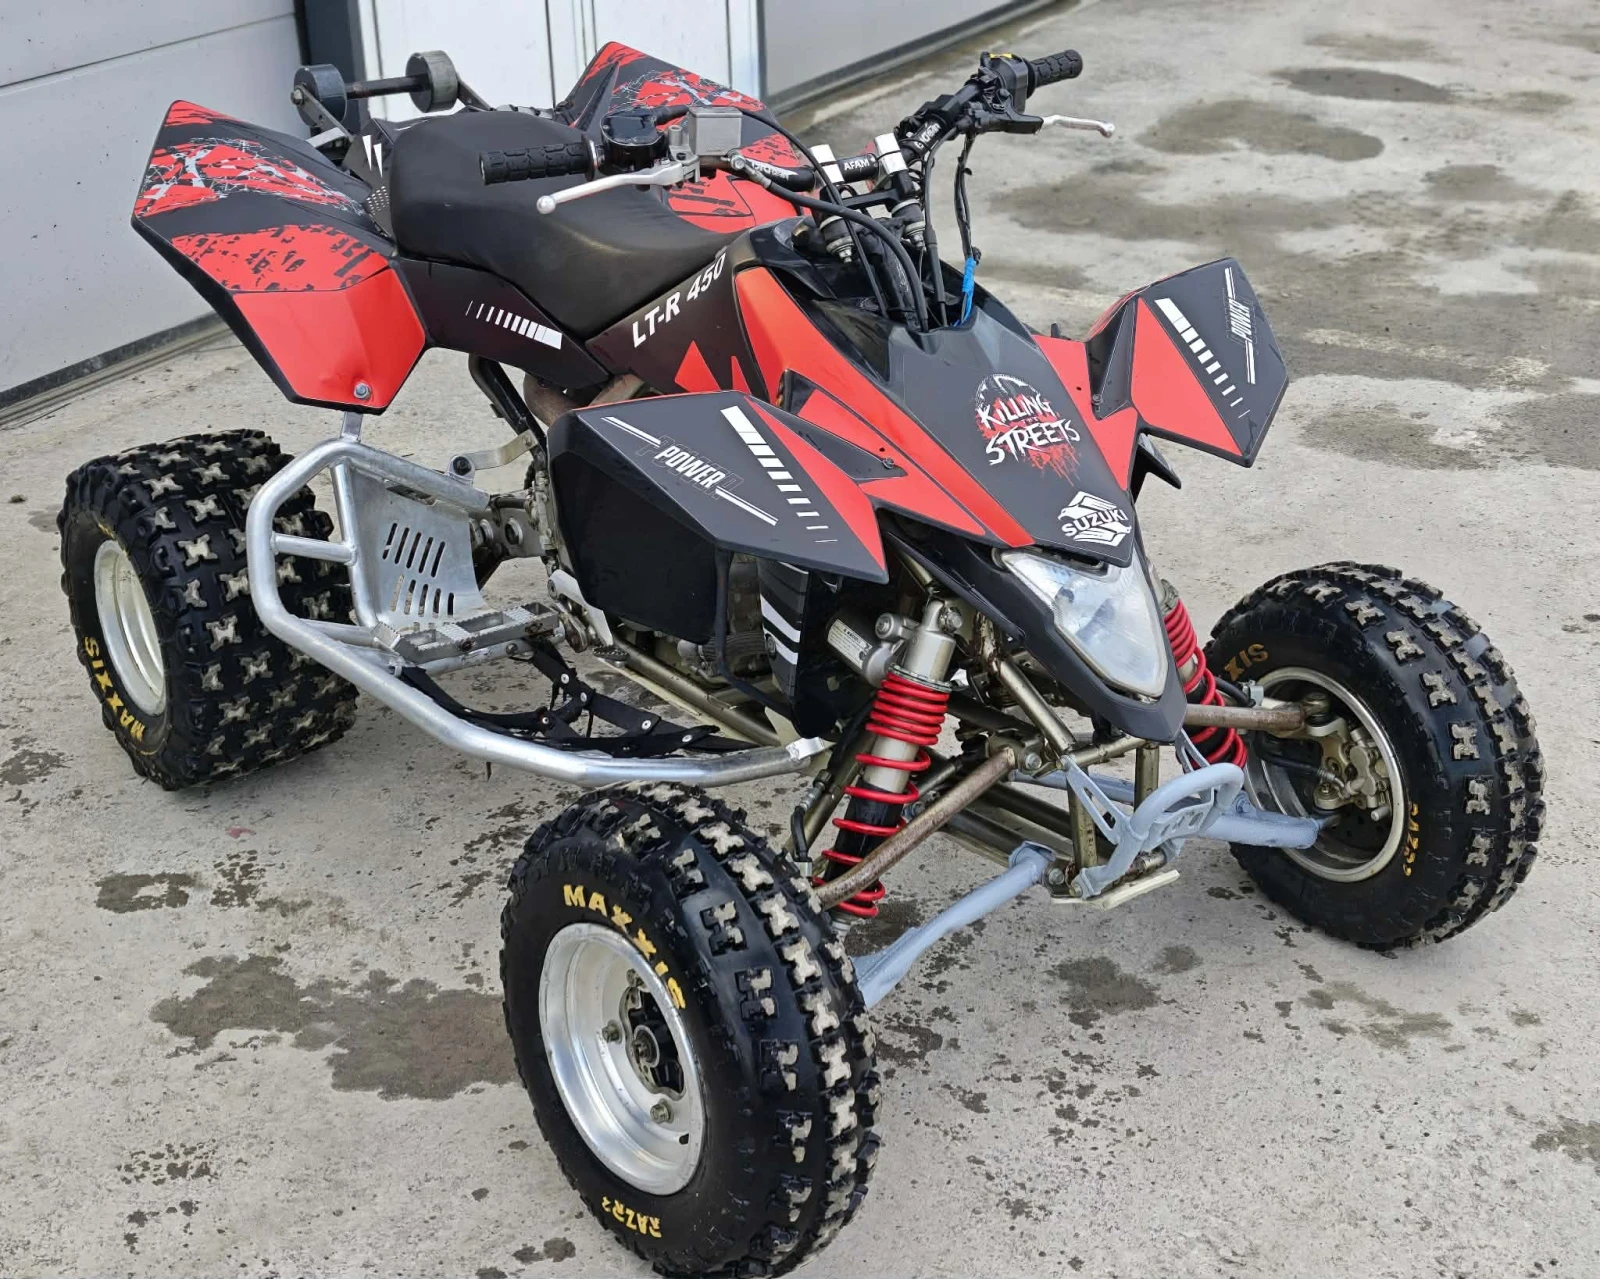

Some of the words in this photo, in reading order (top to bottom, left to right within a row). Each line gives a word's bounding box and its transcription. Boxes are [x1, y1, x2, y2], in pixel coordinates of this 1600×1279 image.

[843, 158, 871, 171] AFAM
[632, 291, 681, 349] LT-R
[686, 251, 727, 302] 450
[1228, 298, 1253, 343] POWER
[976, 393, 1056, 429] KILLING
[985, 418, 1081, 466] STREETS
[653, 445, 726, 489] POWER
[1061, 508, 1129, 537] SUZUKI
[84, 636, 146, 742] MAXXIS
[563, 884, 686, 1010] MAXXIS
